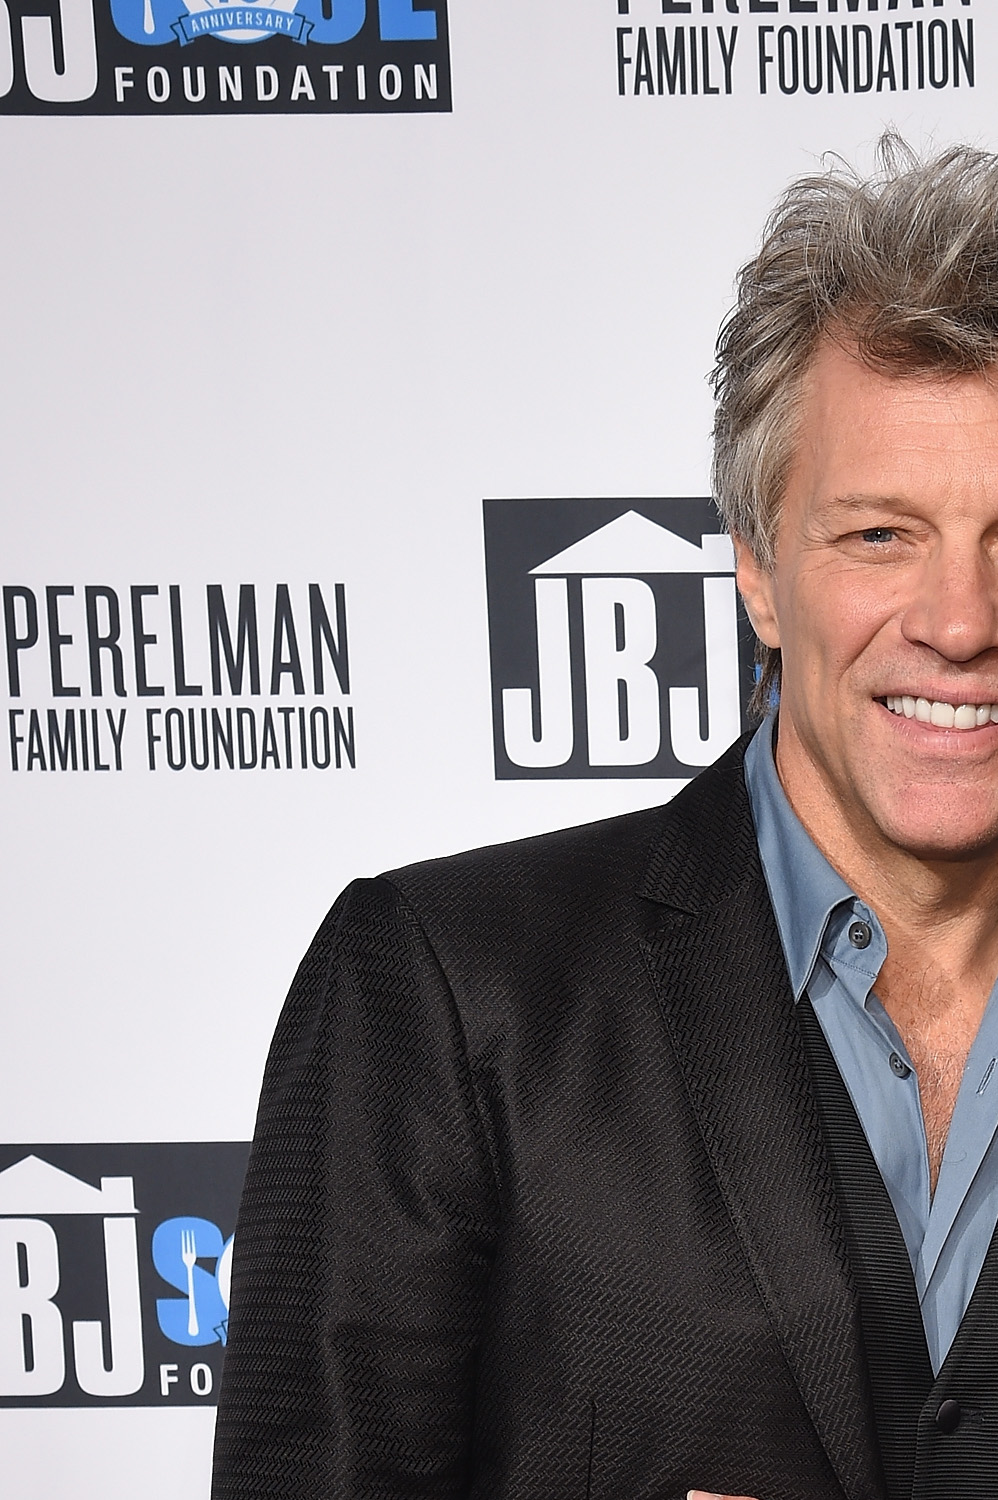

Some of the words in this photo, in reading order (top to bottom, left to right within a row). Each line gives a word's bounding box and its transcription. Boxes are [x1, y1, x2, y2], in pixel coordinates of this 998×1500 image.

[0, 0, 99, 102] J
[191, 11, 295, 31] ANNIVERSARY
[616, 26, 738, 96] FAMILY
[758, 18, 975, 95] FOUNDATION
[114, 63, 439, 102] FOUNDATION
[3, 583, 351, 698] PERELMAN
[502, 577, 742, 768] JBJ
[9, 708, 126, 771] FAMILY
[146, 706, 357, 770] FOUNDATION
[152, 1216, 235, 1347] S
[160, 1363, 213, 1396] FO
